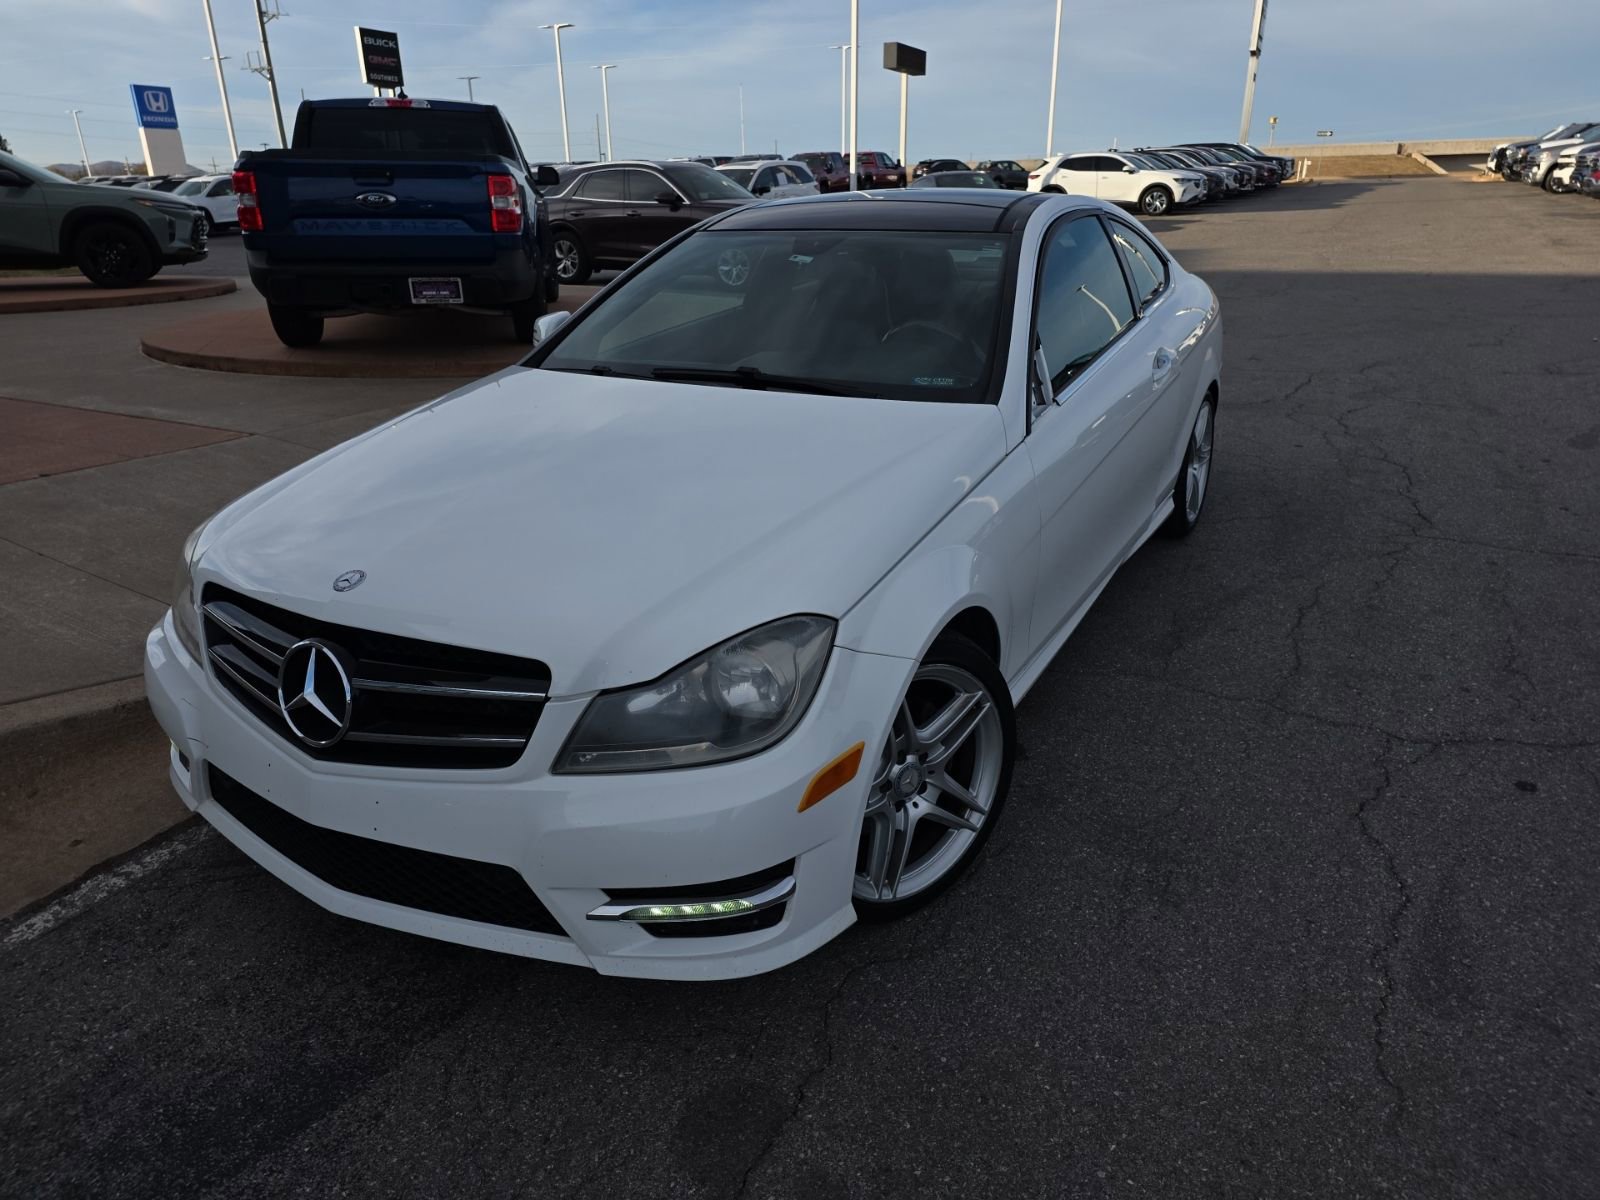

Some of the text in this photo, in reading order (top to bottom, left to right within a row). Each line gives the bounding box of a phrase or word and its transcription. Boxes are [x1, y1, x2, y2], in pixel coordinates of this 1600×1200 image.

[363, 36, 397, 48] BUICK
[368, 55, 398, 66] GMC
[143, 115, 177, 123] HONDA
[300, 220, 463, 231] MAVERICK
